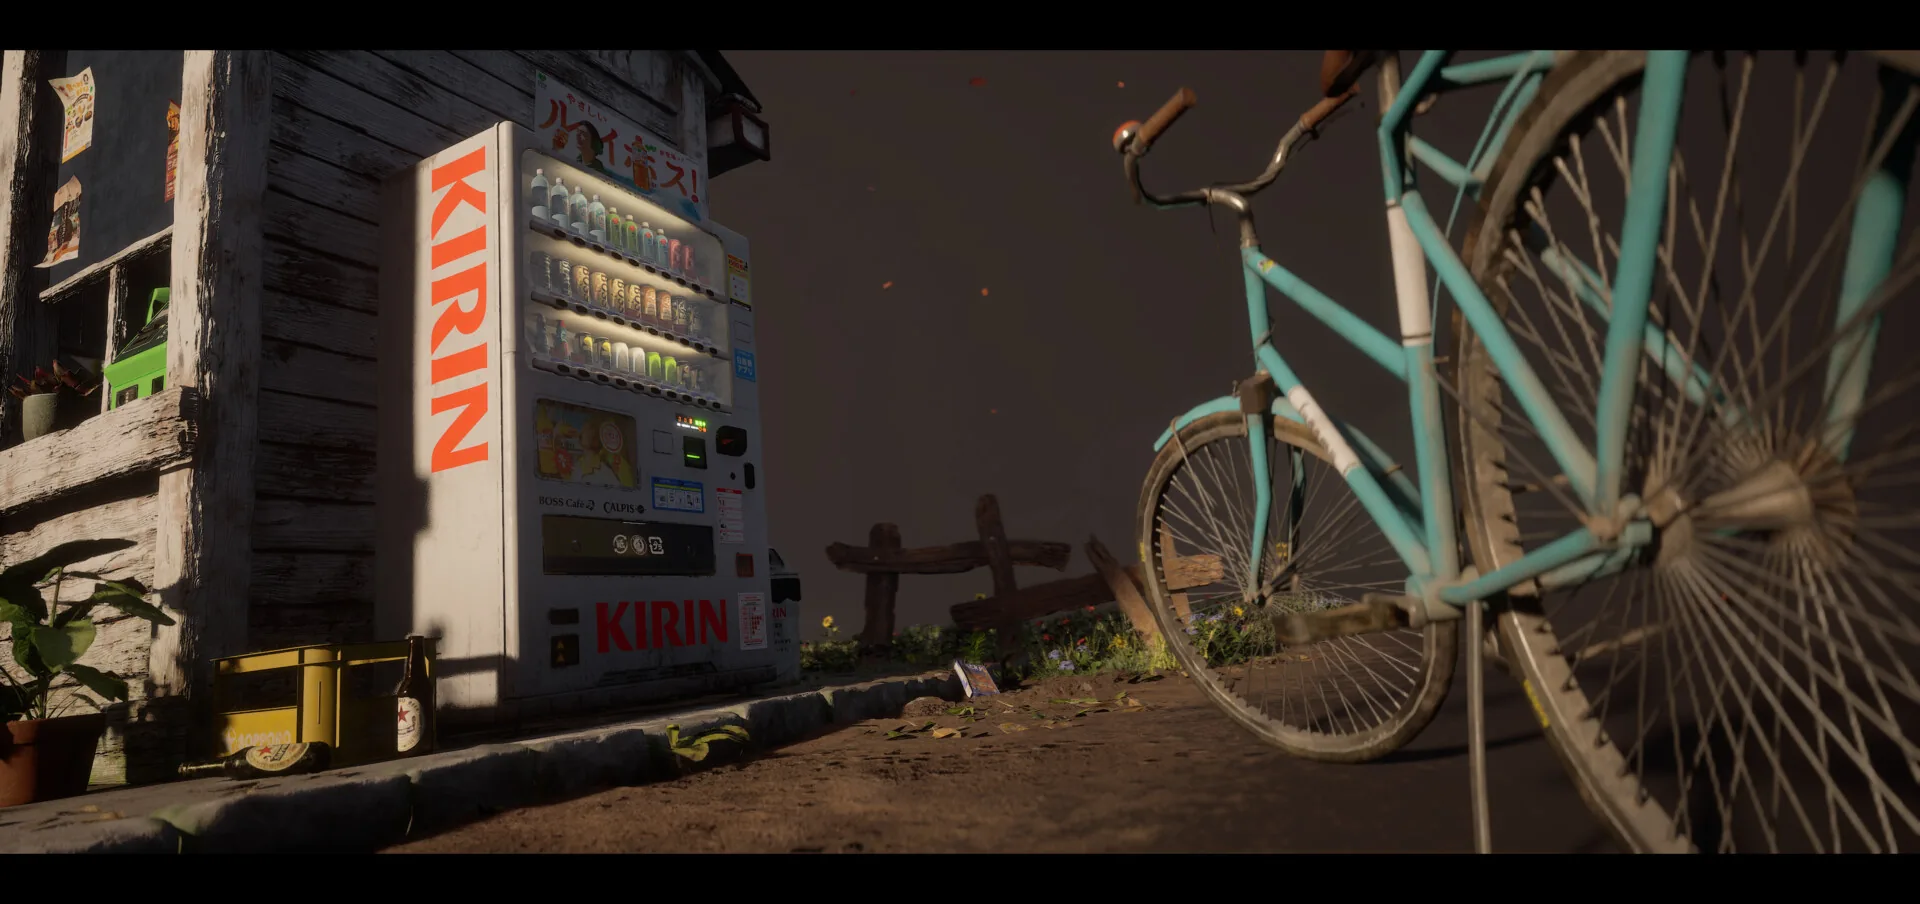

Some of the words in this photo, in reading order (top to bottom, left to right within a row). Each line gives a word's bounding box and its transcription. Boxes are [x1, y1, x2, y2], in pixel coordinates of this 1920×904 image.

[431, 145, 489, 473] KIRIN
[539, 496, 564, 507] BOSS
[566, 498, 585, 508] Café
[603, 501, 635, 514] CALPIS
[596, 599, 728, 653] KIRIN
